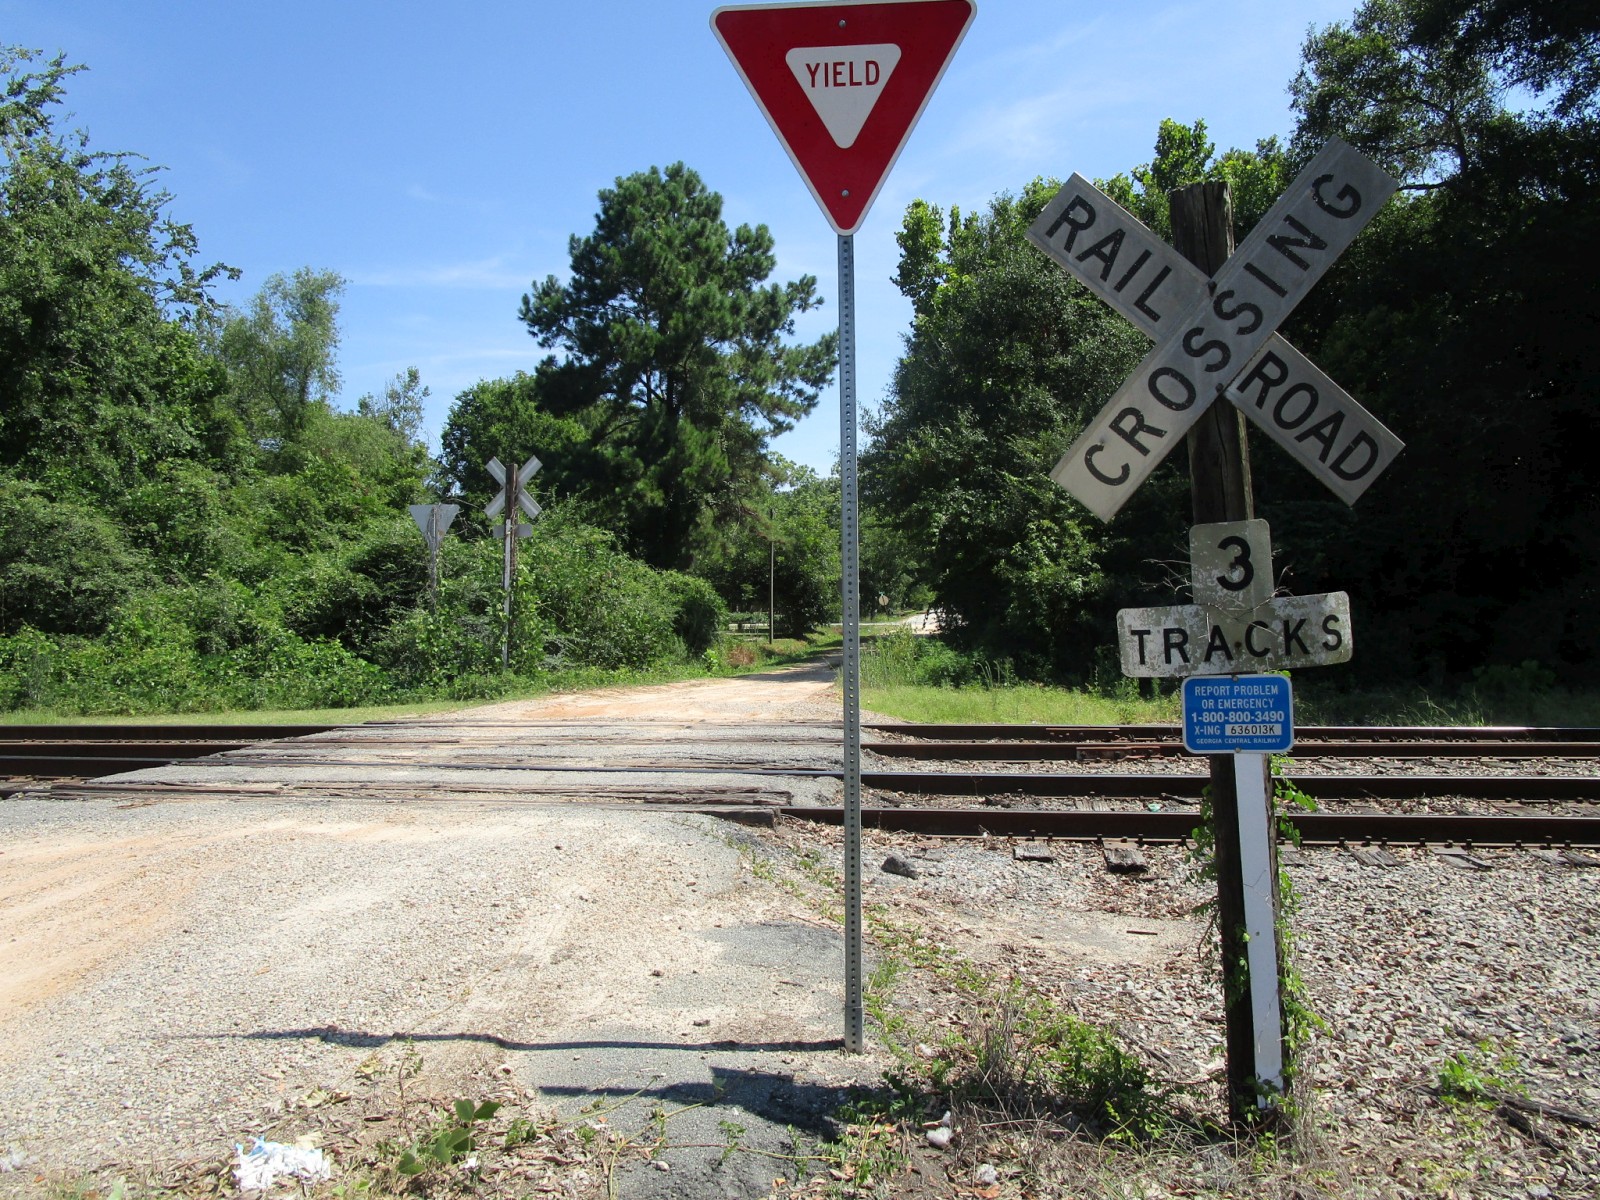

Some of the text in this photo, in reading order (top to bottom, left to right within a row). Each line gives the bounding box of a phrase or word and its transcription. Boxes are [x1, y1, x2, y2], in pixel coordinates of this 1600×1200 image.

[805, 60, 880, 88] YIELD
[1045, 194, 1380, 482] RAIL ROAD
[1083, 173, 1362, 487] CROSSING
[1216, 535, 1255, 592] 3
[1130, 614, 1343, 665] TRACKS
[1194, 684, 1279, 697] REPORT PROBLEM
[1201, 698, 1275, 709] OR EMERGENCY
[1191, 710, 1285, 723] 1-800-800-3490
[1194, 724, 1276, 735] X-ING 636013K
